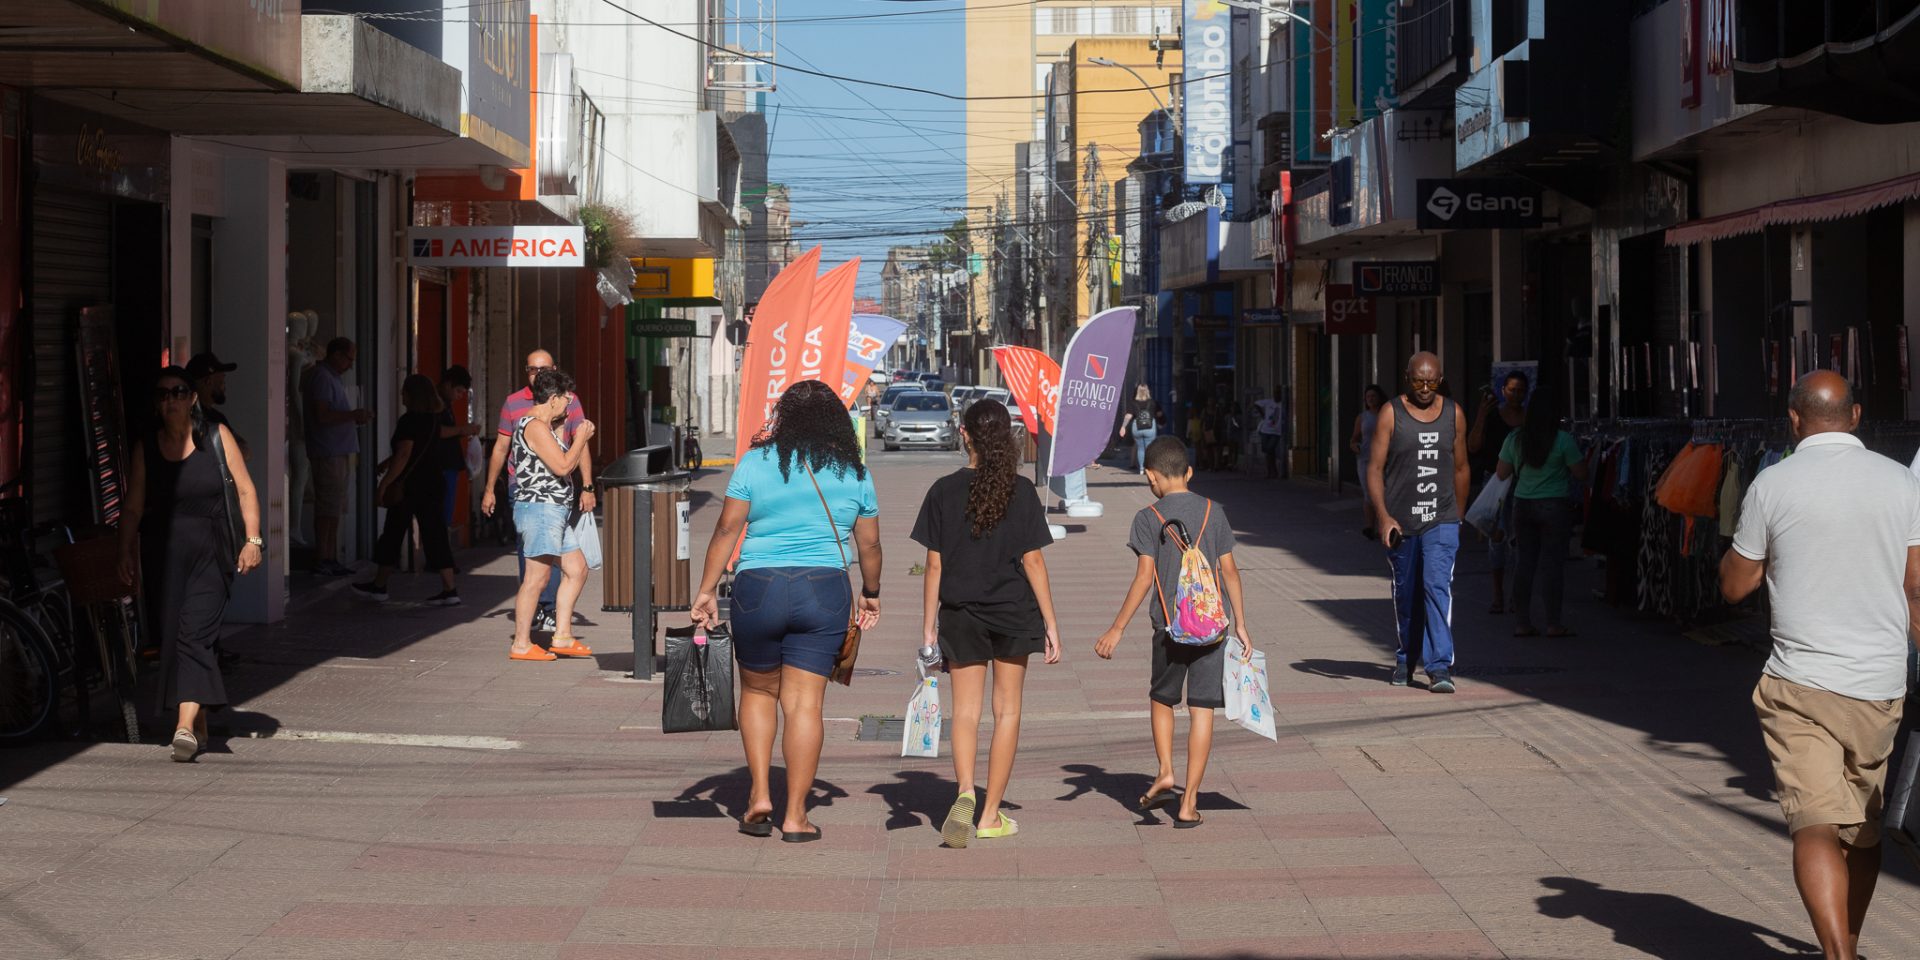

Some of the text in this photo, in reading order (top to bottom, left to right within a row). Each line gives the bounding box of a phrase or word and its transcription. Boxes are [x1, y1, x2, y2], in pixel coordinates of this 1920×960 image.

[1196, 25, 1226, 176] Colombo
[1466, 192, 1535, 217] Gang
[449, 236, 578, 257] AMÉRICA
[1384, 265, 1433, 283] FRANCO
[1332, 296, 1369, 322] gzt
[636, 324, 663, 333] QUERO
[801, 325, 823, 382] ICA
[1067, 379, 1116, 404] FRANCO
[1067, 399, 1112, 411] GIORGI
[1416, 431, 1439, 508] BEAST
